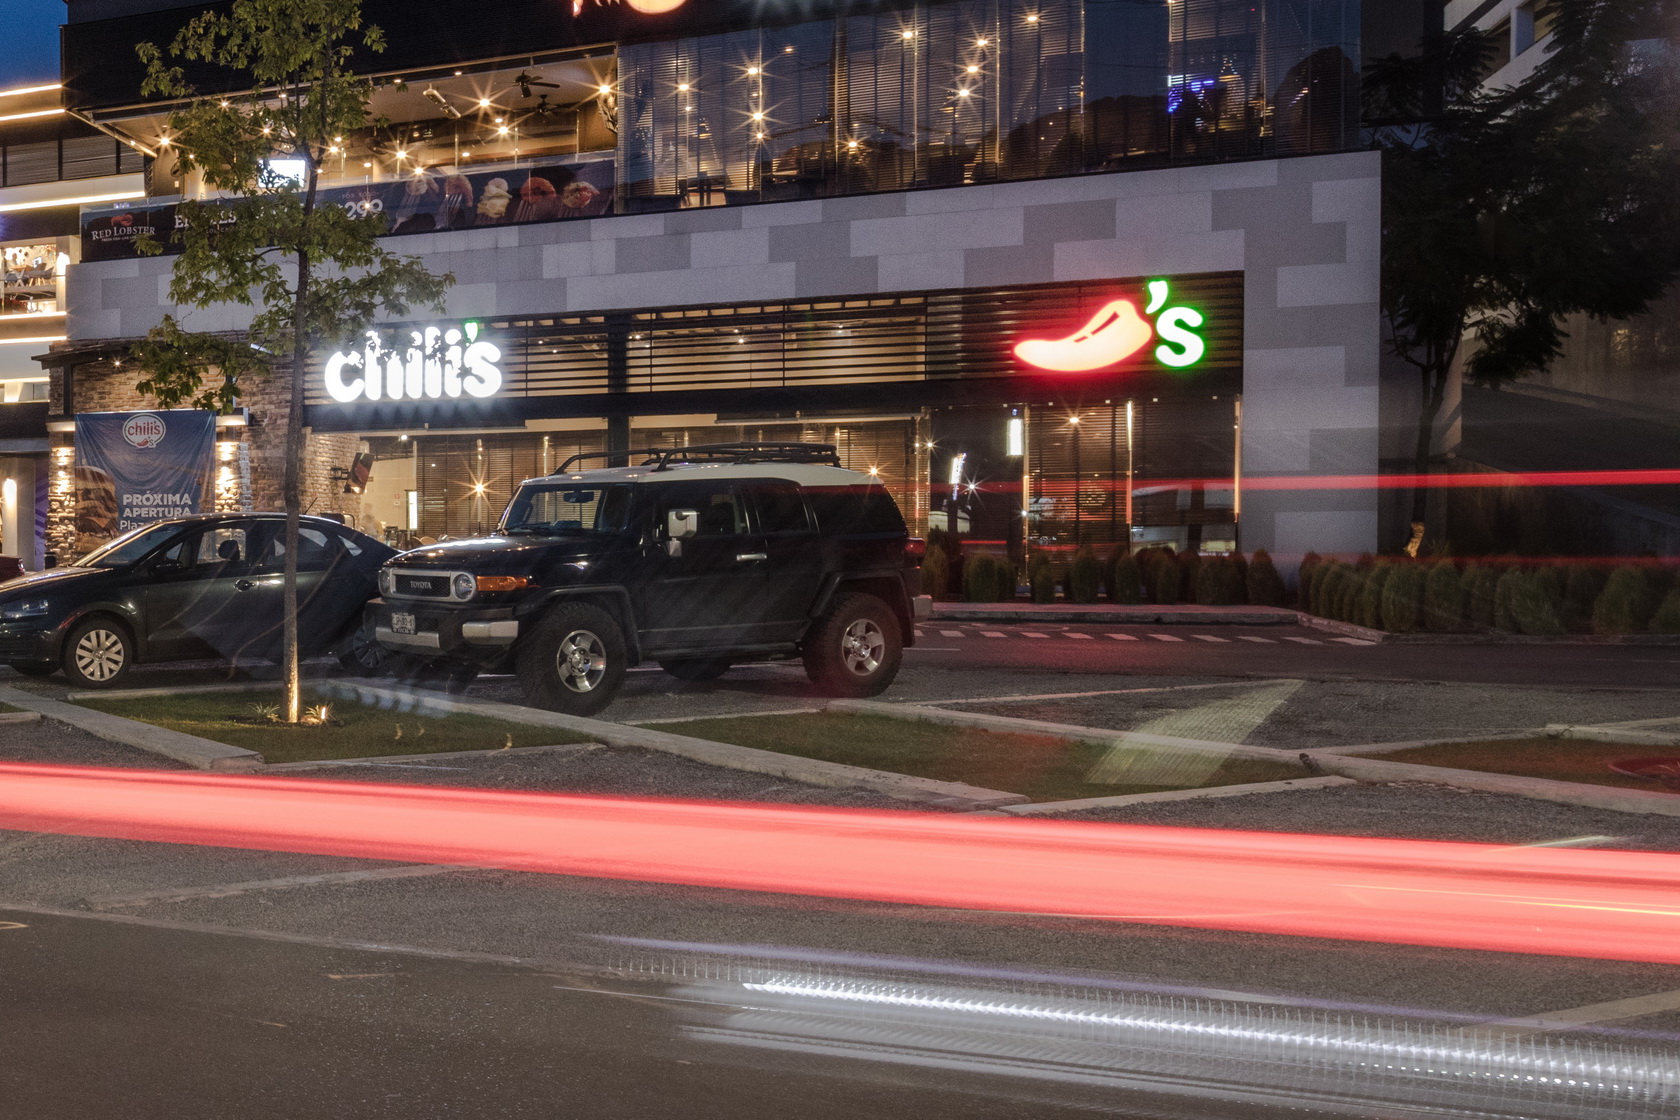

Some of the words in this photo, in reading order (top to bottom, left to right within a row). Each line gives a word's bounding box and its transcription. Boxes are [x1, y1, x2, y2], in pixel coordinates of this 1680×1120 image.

[337, 199, 383, 220] 299
[91, 229, 112, 240] RED
[113, 226, 155, 236] LOBSTER
[1145, 280, 1205, 367] 's
[324, 322, 503, 403] chili's
[127, 421, 161, 436] chili's
[123, 491, 192, 505] PRÓXIMA
[123, 507, 192, 517] APERTURA
[410, 581, 432, 589] TOYOTA
